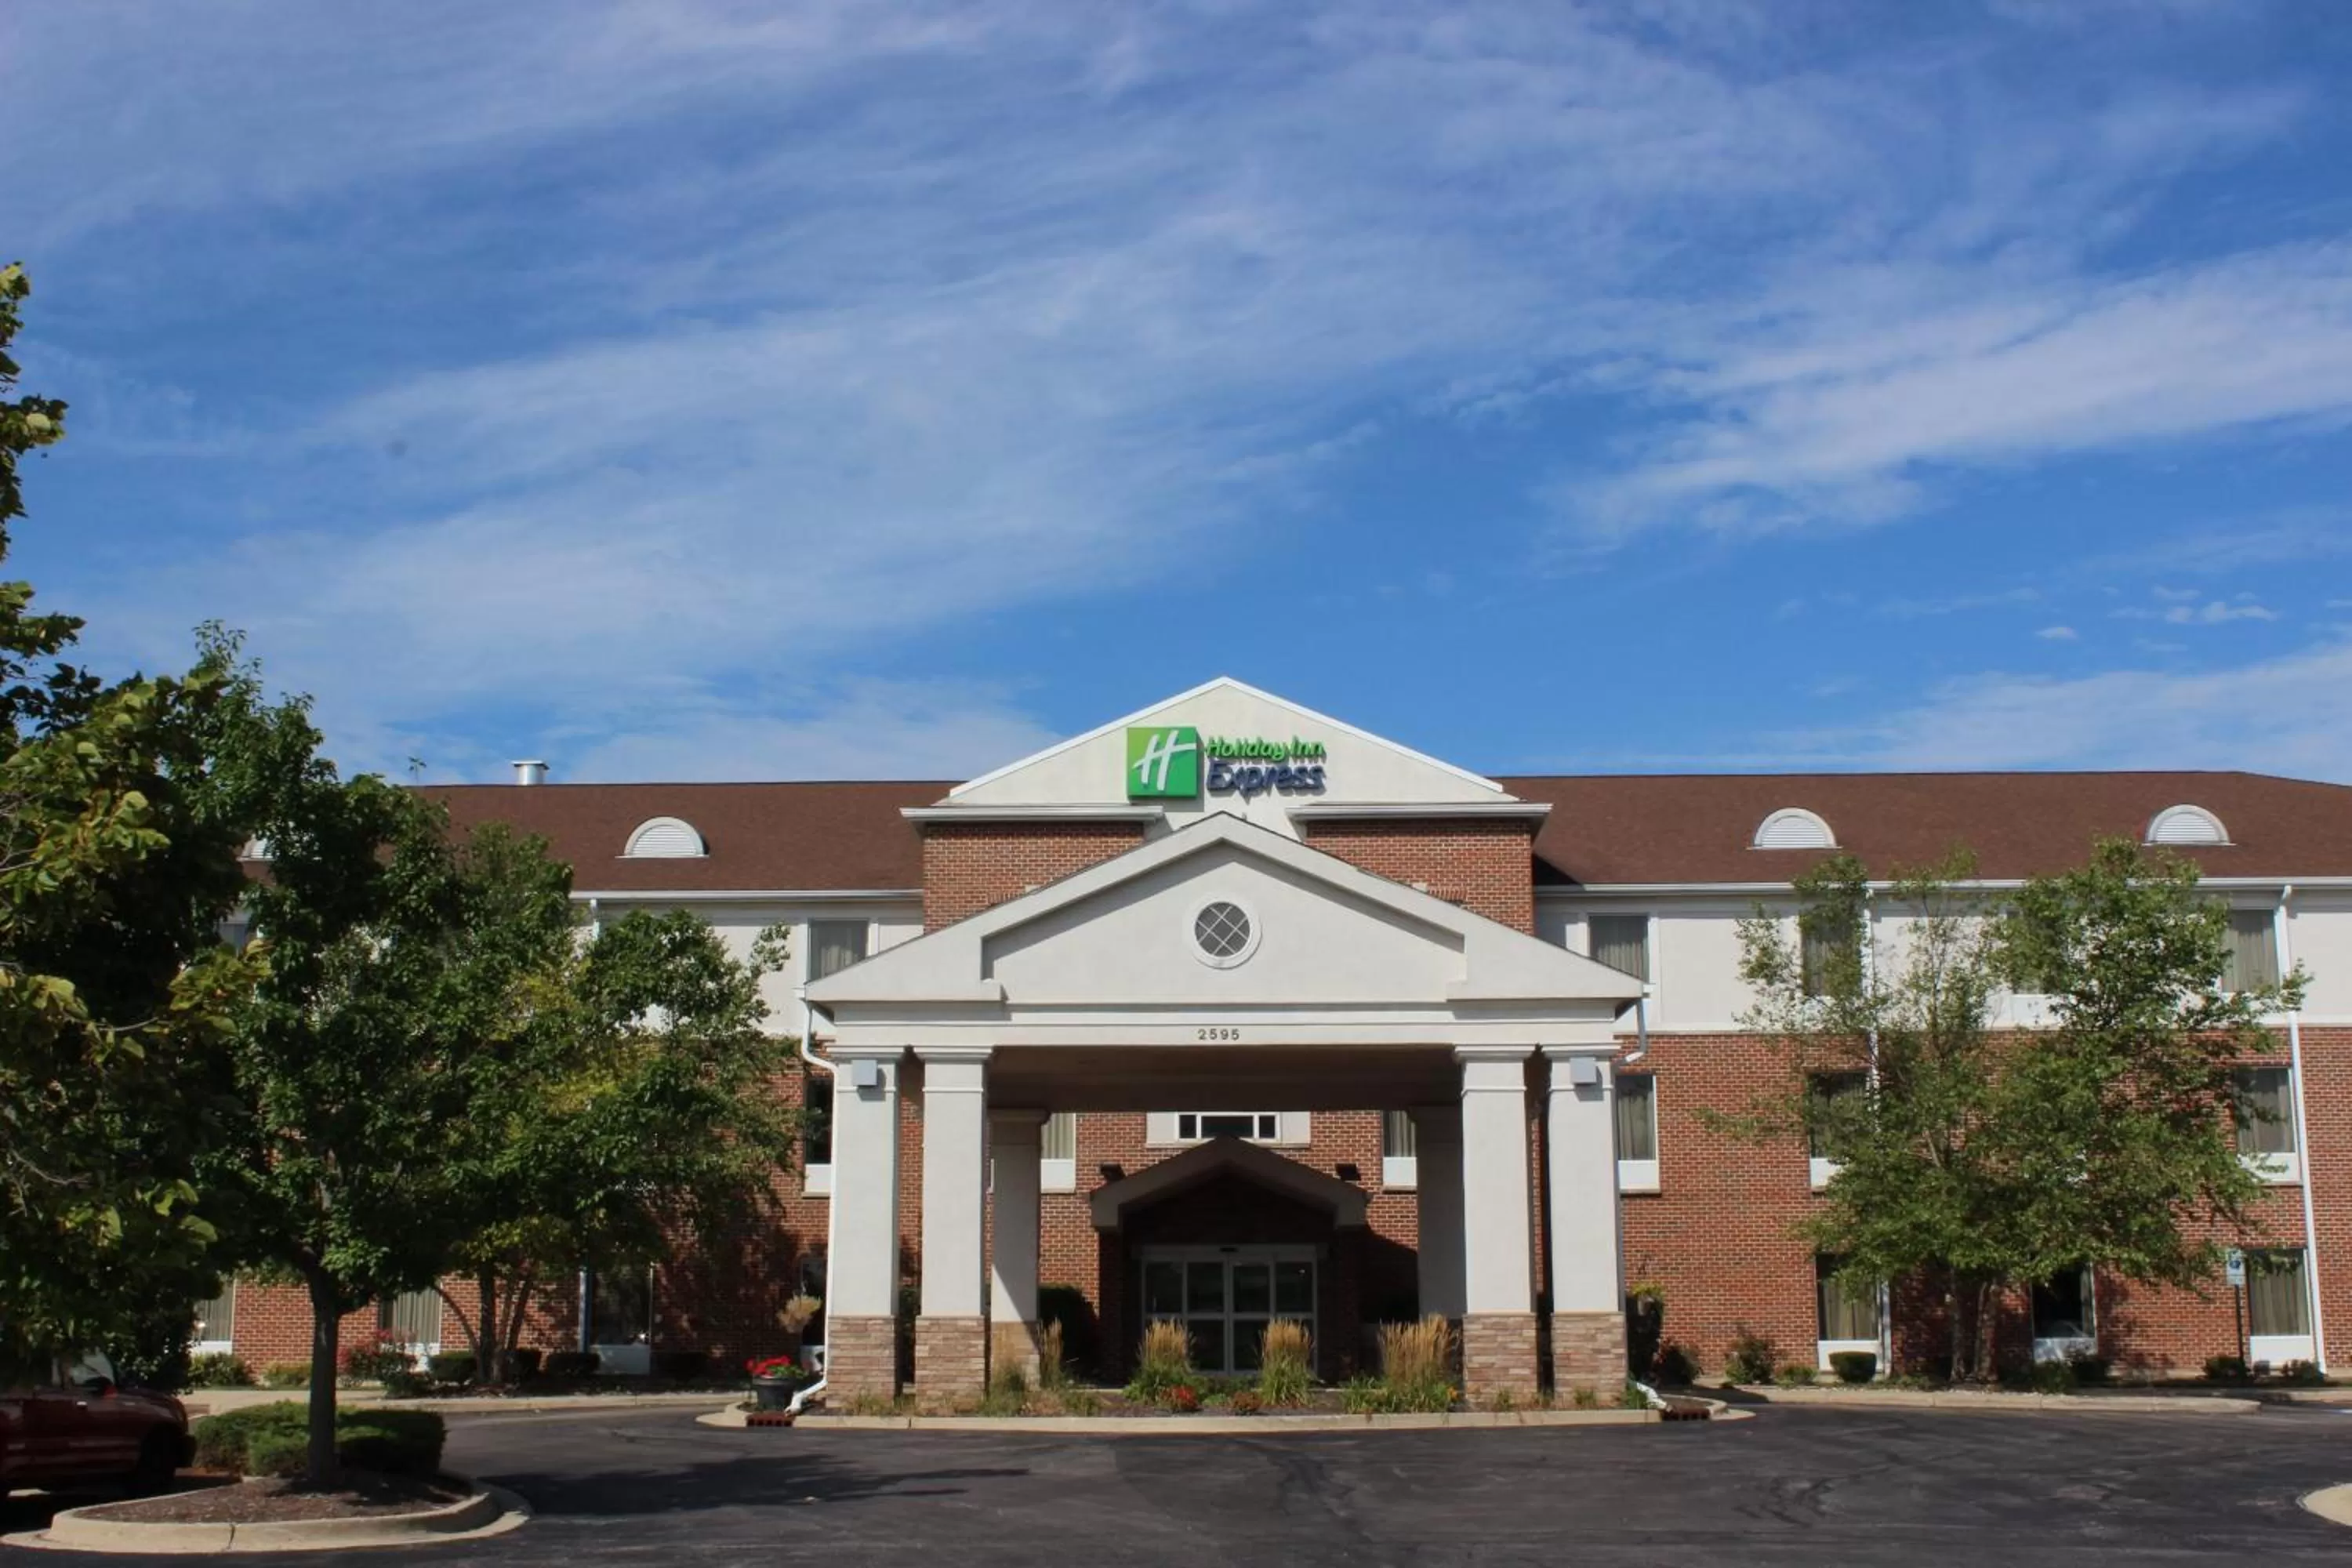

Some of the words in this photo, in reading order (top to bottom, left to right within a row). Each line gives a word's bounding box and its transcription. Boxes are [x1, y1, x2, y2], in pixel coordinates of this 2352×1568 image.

[1206, 736, 1286, 761] Holiday
[1290, 735, 1324, 757] Inn
[1207, 758, 1327, 797] Express
[1197, 1028, 1240, 1041] 2595
